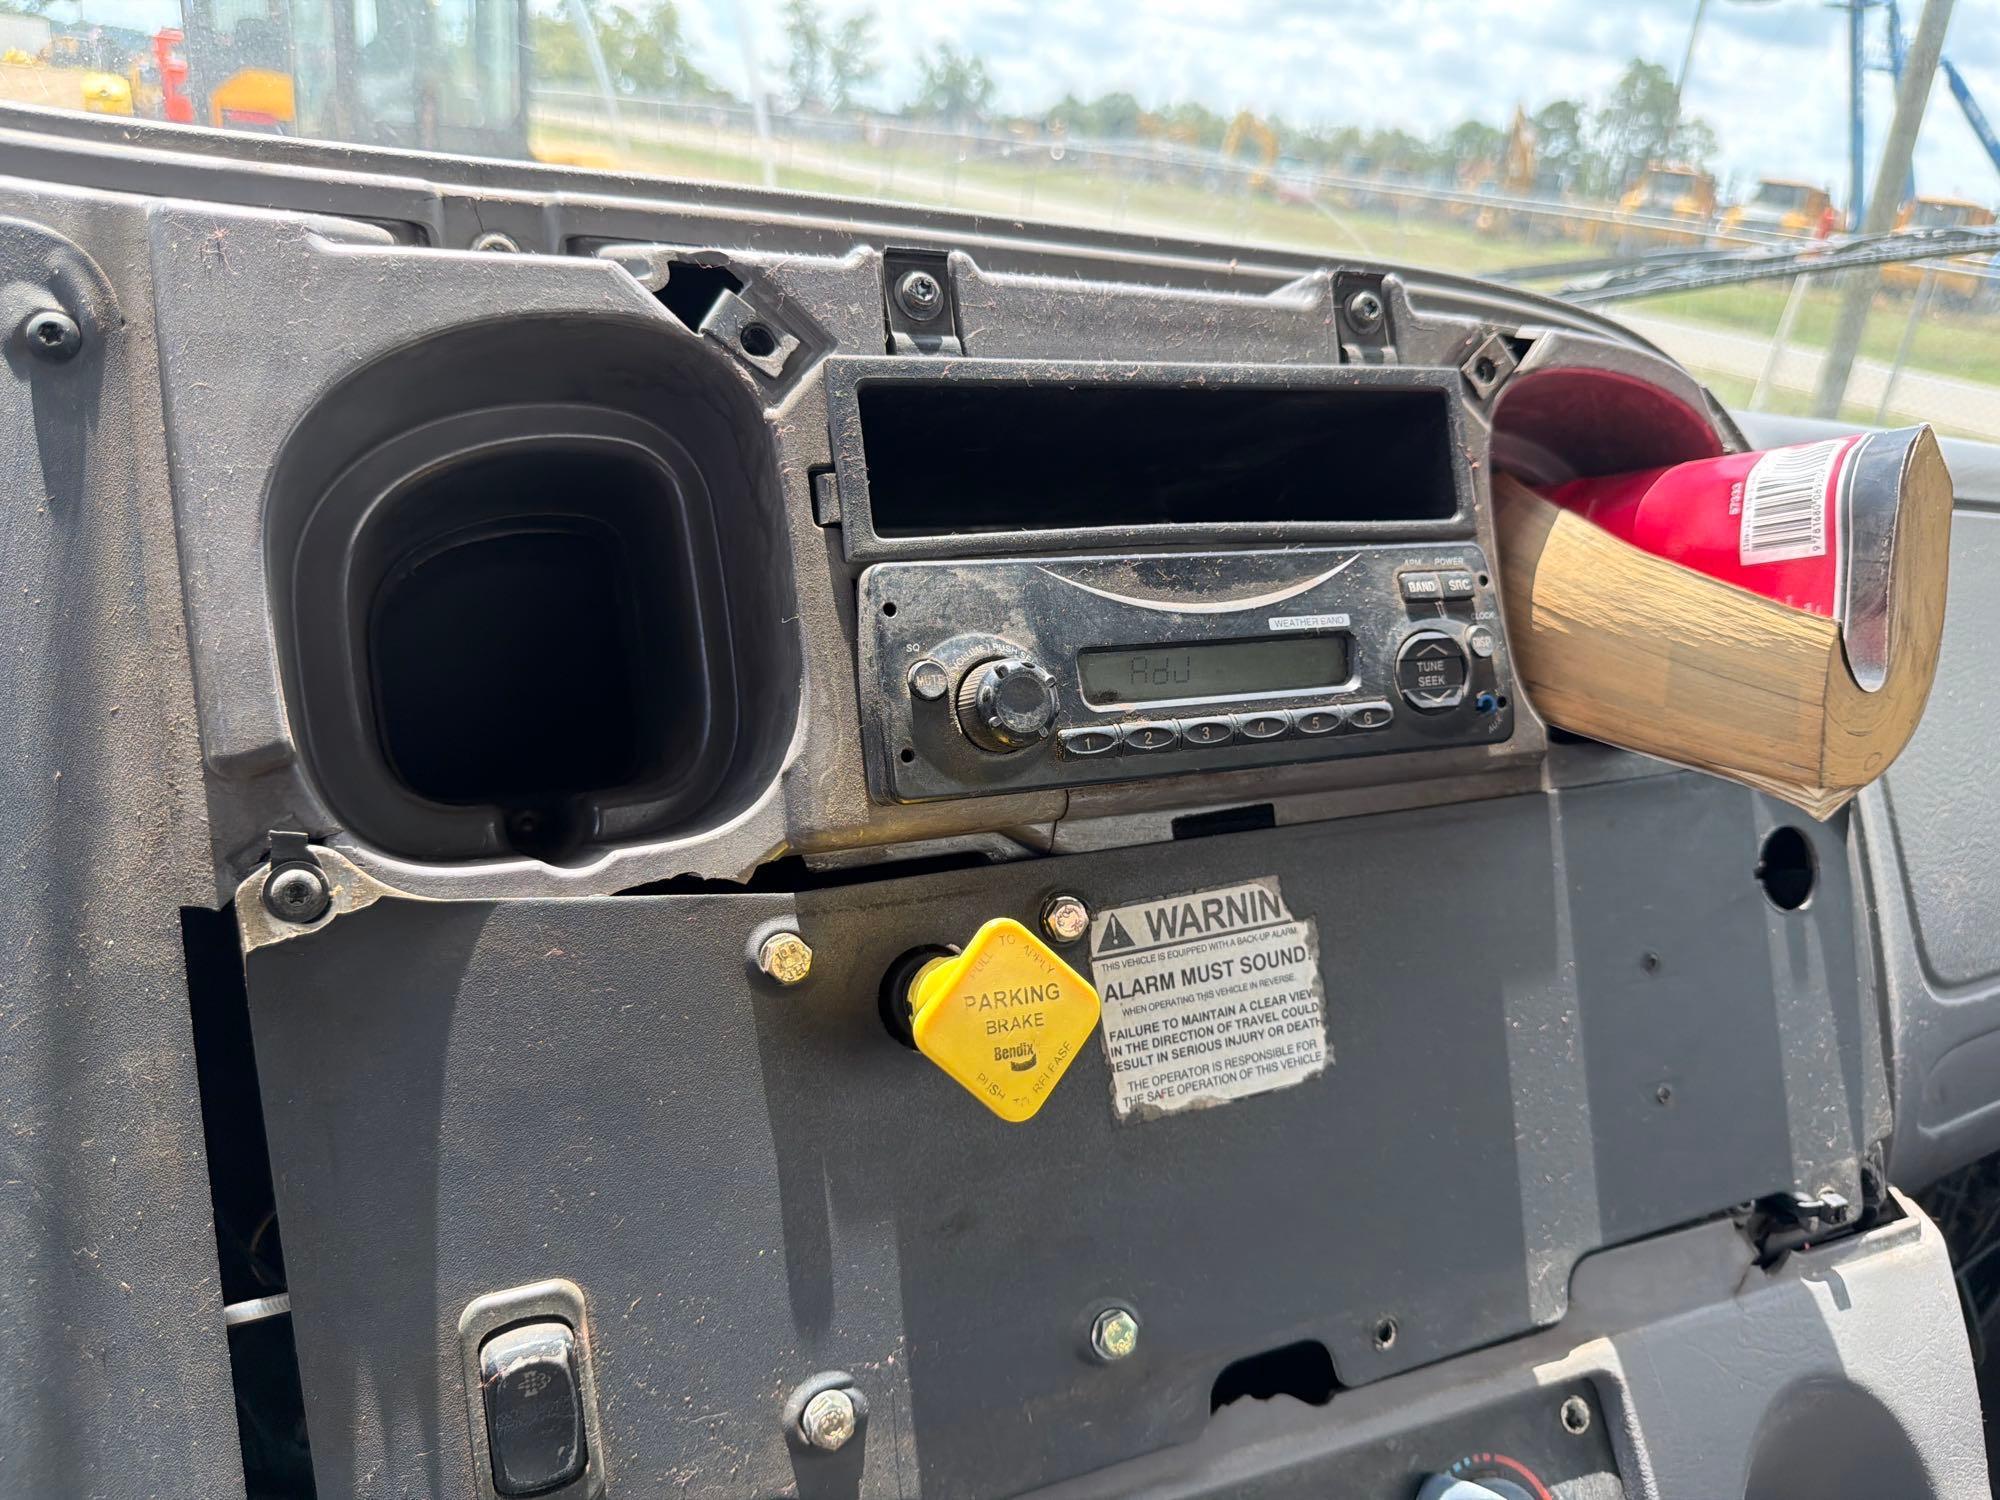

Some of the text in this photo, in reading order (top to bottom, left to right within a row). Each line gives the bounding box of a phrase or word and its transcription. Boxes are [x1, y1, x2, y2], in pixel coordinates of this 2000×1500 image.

[1434, 557, 1464, 566] POWER
[1408, 581, 1435, 593] BAND
[1448, 579, 1472, 591] SRC
[1274, 616, 1344, 628] WEATHER BAND
[906, 643, 920, 653] SQ
[1472, 636, 1491, 647] DISP
[954, 644, 985, 668] VOLUME
[992, 643, 1018, 655] PUSH
[1417, 660, 1444, 673] TUNE
[916, 674, 944, 687] MUTE
[1418, 675, 1445, 687] SEEK
[1312, 716, 1320, 730] 5
[1364, 711, 1372, 725] 6
[1202, 726, 1210, 740] 3
[1257, 721, 1265, 734] 4
[1085, 738, 1091, 750] 1
[1145, 732, 1153, 745] 2
[999, 934, 1016, 946] TO
[1023, 944, 1056, 974] APPLY
[1102, 927, 1297, 972] THIS VEHICLE IS EQUIPPED WITH A BACK-UP ALARM
[1104, 971, 1176, 1003] ALARM
[1181, 959, 1234, 987] MUST
[964, 982, 1060, 1012] PARKING
[1122, 1004, 1147, 1017] WHEN
[1148, 993, 1195, 1011] OPERATING
[1196, 990, 1214, 1001] THIS
[1215, 982, 1248, 997] VEHICLE
[1249, 981, 1257, 990] IN
[986, 1012, 1045, 1035] BRAKE
[1109, 1021, 1160, 1042] FAILURE
[1162, 1017, 1179, 1030] TO
[1181, 1004, 1236, 1026] MAINTAIN
[1239, 1003, 1247, 1013] A
[1249, 994, 1287, 1011] CLEAR
[1110, 1002, 1319, 1058] IN THE DIRECTION OF TRAVEL COULD
[1157, 1051, 1168, 1063] IN
[1171, 1039, 1223, 1060] SERIOUS
[1224, 1029, 1265, 1047] INJURY
[1267, 1025, 1284, 1037] OR
[994, 1042, 1034, 1061] Bendix
[1128, 1039, 1318, 1092] THE OPERATOR IS RESPONSIBLE FOR
[1147, 1085, 1175, 1102] SAFE
[1177, 1072, 1237, 1096] OPERATION
[1239, 1067, 1254, 1080] OF
[1255, 1061, 1278, 1076] THIS
[1280, 1050, 1322, 1070] VEHICLE
[976, 1073, 1007, 1100] PUSH
